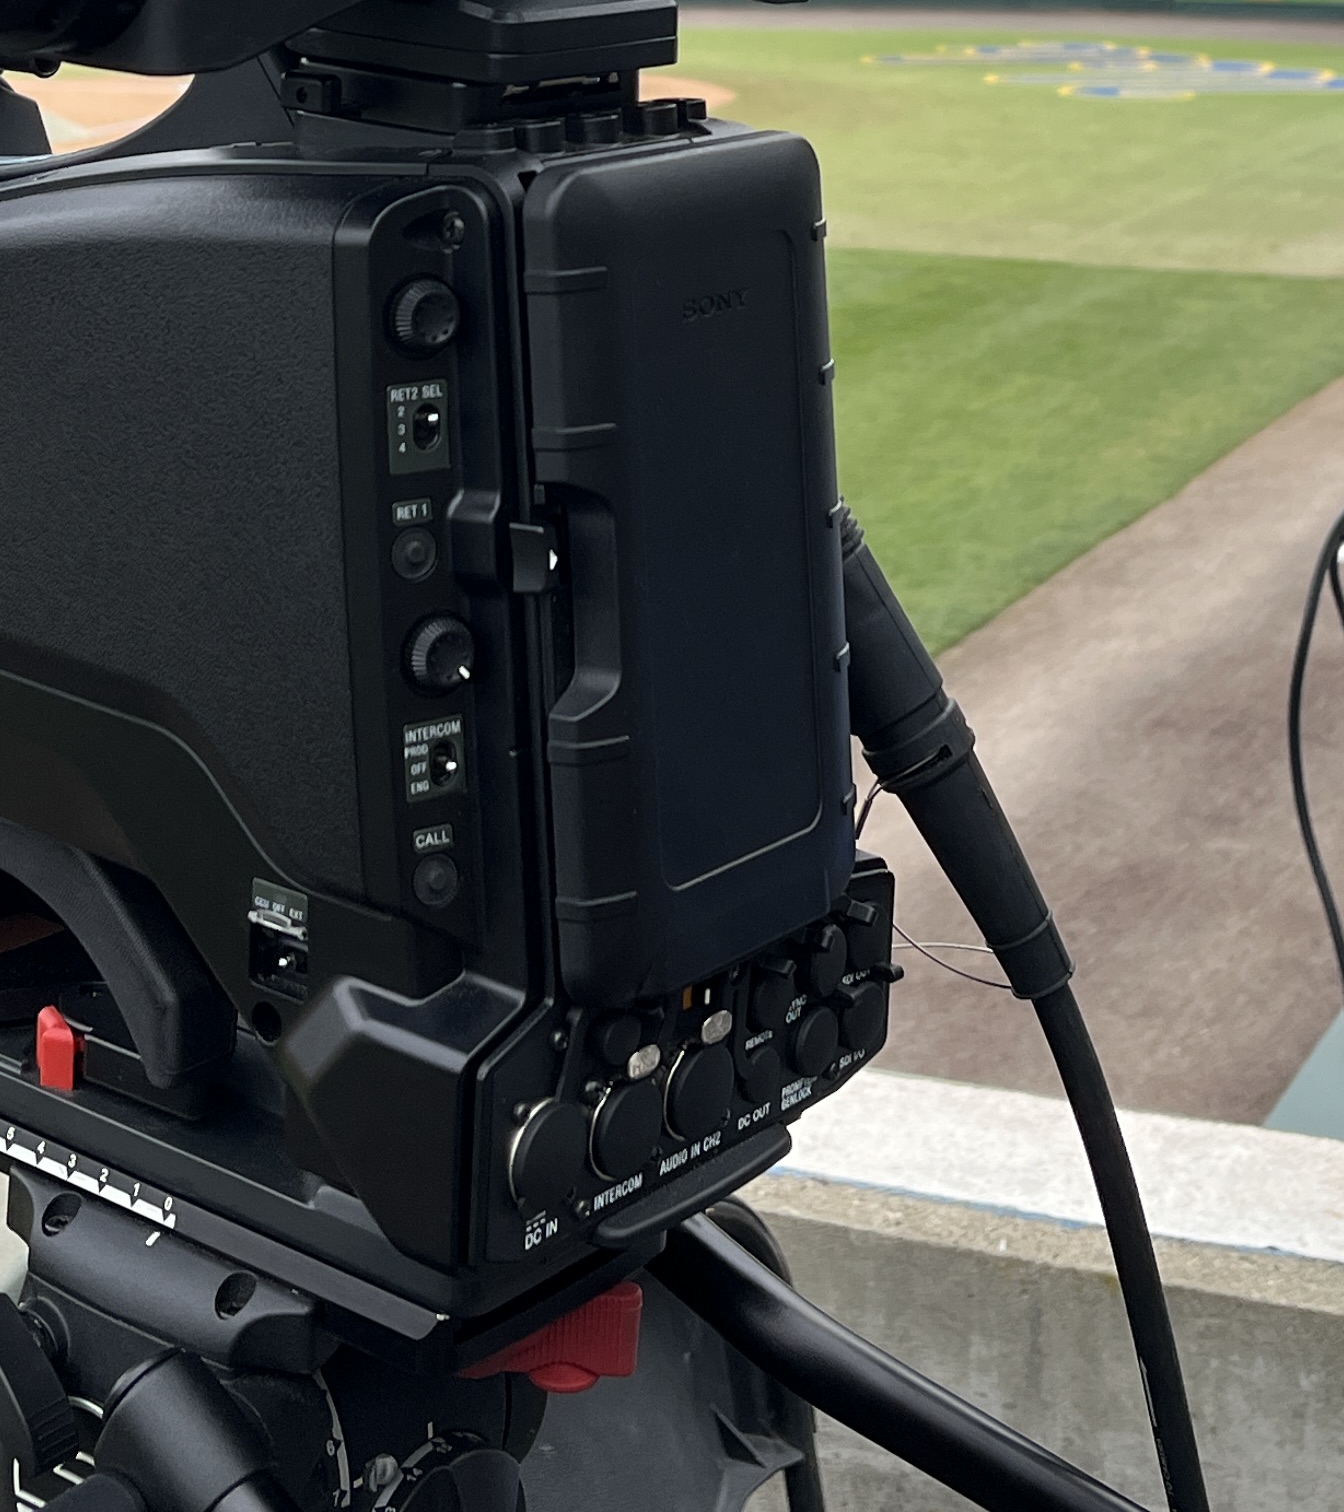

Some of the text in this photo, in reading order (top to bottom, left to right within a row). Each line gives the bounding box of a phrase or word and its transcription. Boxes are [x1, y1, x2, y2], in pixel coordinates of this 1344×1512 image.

[682, 289, 748, 319] SONY
[390, 384, 443, 403] RET2 SEL
[397, 405, 405, 418] 2
[398, 442, 406, 453] 4
[396, 504, 417, 521] RET
[404, 719, 461, 744] INTERCOM
[404, 743, 429, 760] PROD
[410, 761, 427, 776] OFF
[415, 830, 450, 848] CALL
[789, 994, 807, 1011] YNC
[785, 1006, 802, 1024] OUT
[839, 1053, 852, 1069] SDI
[737, 1101, 771, 1130] DC OUT
[659, 1130, 721, 1176] AUDIO IN CH2
[7, 1127, 15, 1140] 5
[37, 1141, 46, 1155] 4
[68, 1153, 77, 1168] 3
[100, 1168, 109, 1183] 2
[133, 1182, 141, 1196] 1
[164, 1196, 173, 1211] 0
[593, 1172, 643, 1212] INTERCOM
[524, 1218, 558, 1251] DC IN
